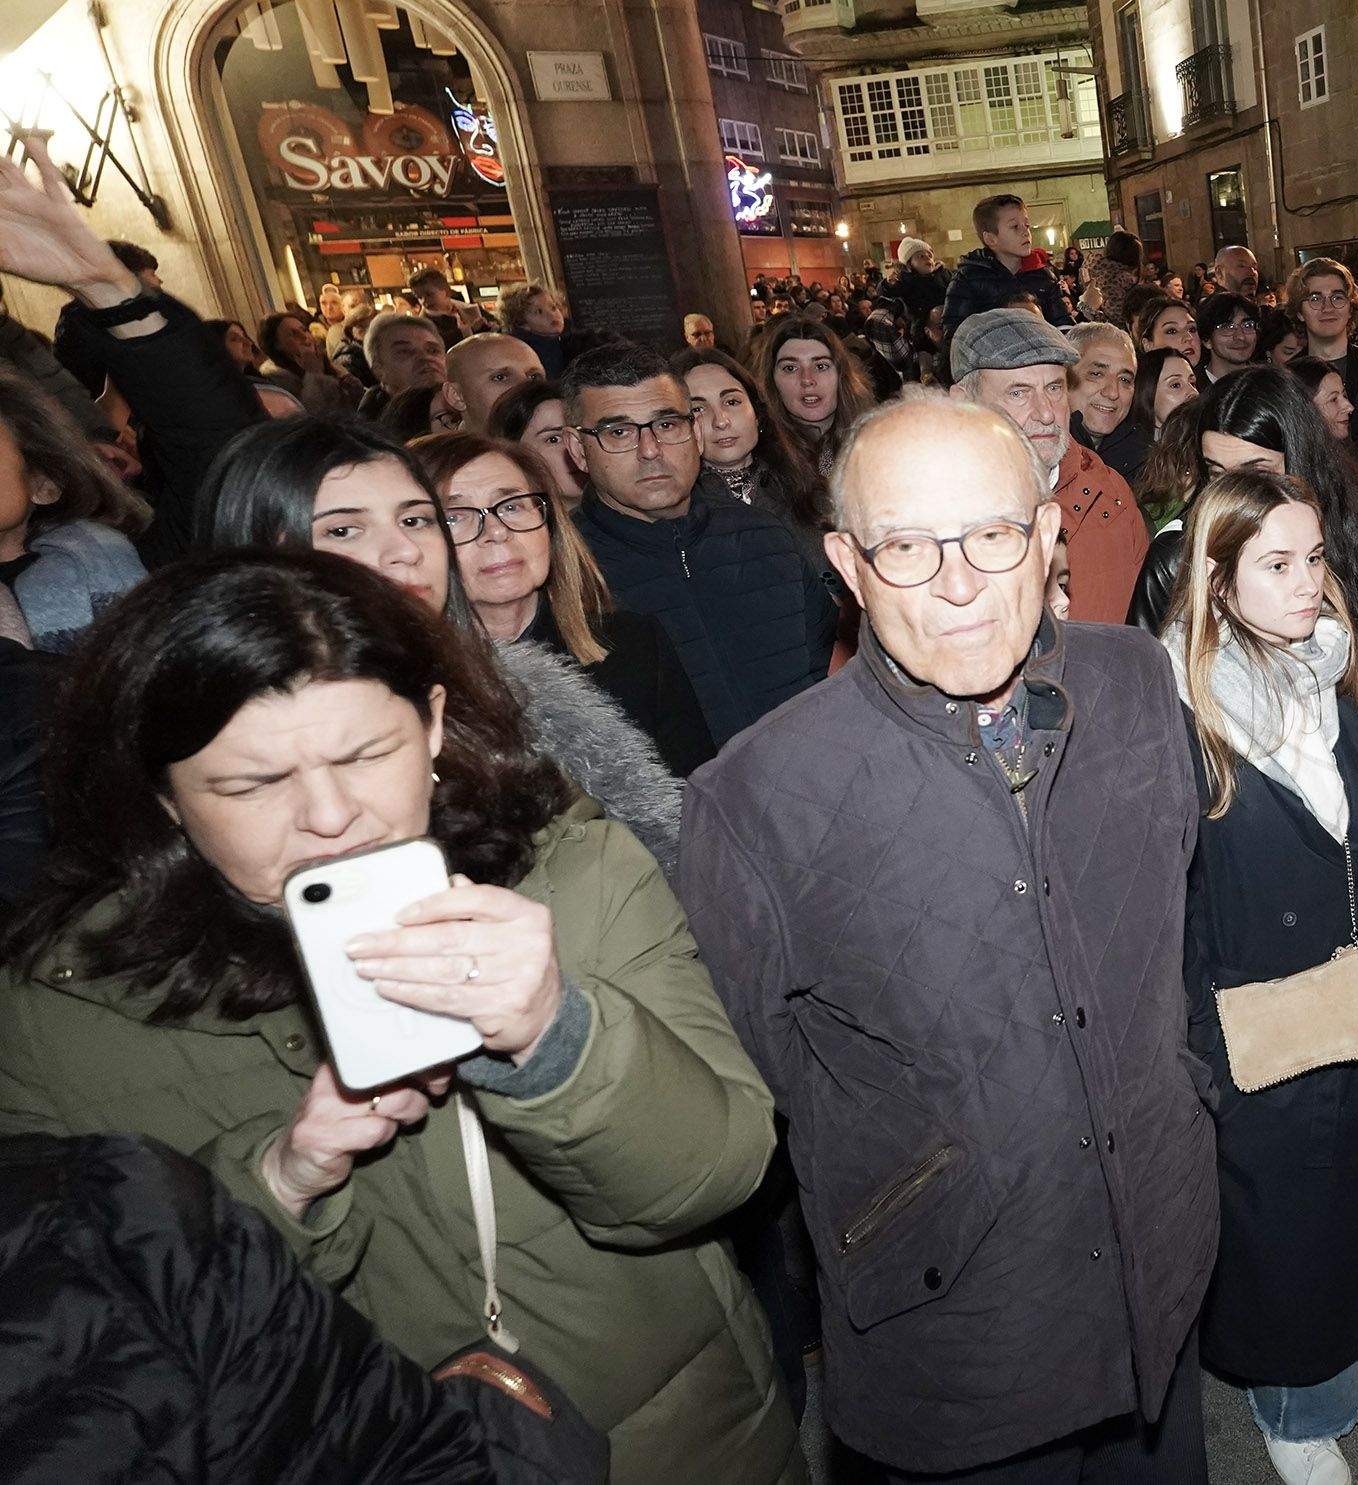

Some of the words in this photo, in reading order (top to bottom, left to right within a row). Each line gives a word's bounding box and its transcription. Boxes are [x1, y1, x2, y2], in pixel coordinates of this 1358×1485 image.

[554, 63, 584, 75] PRAZA
[553, 80, 594, 92] OURENSE
[280, 136, 458, 199] Savoy
[420, 228, 450, 236] DIRECTO
[1079, 237, 1105, 249] BOTICA
